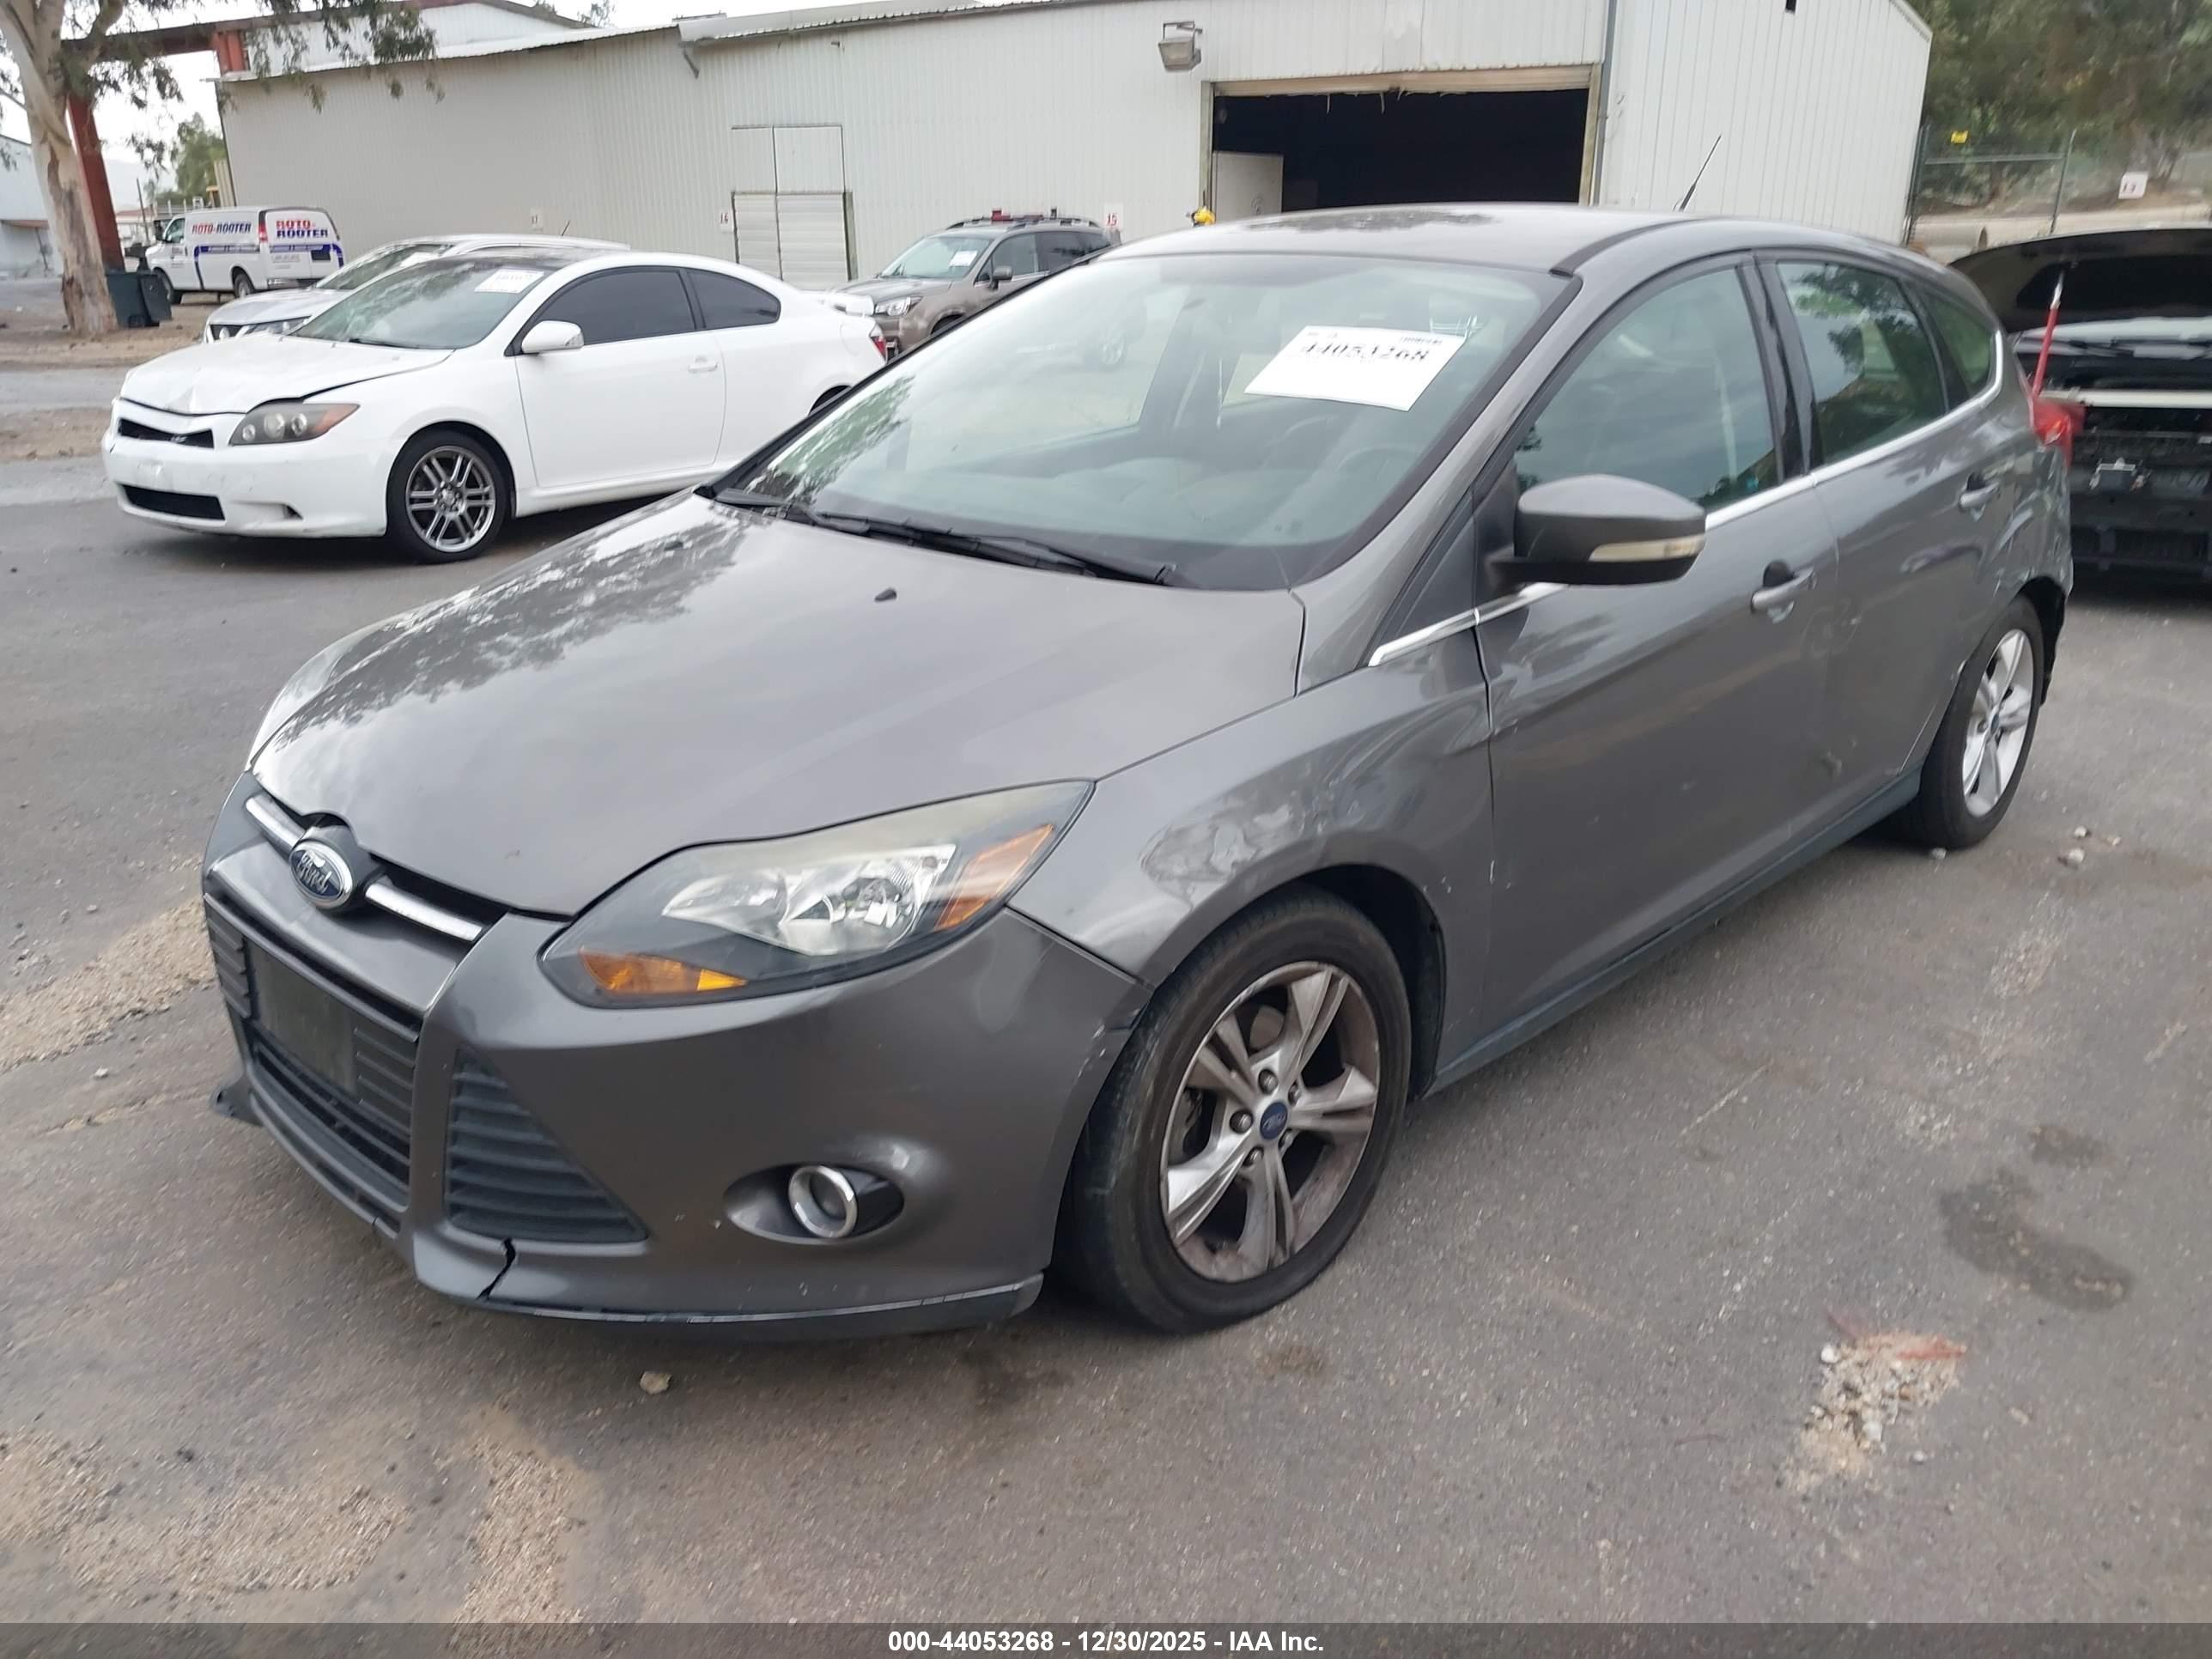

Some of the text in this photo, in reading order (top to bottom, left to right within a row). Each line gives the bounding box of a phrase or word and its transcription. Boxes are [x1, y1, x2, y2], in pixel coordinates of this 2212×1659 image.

[191, 222, 252, 234] ROTO-ROOTER
[276, 220, 315, 229] ROTO-
[276, 229, 329, 239] ROOTER
[295, 851, 332, 895] Ford
